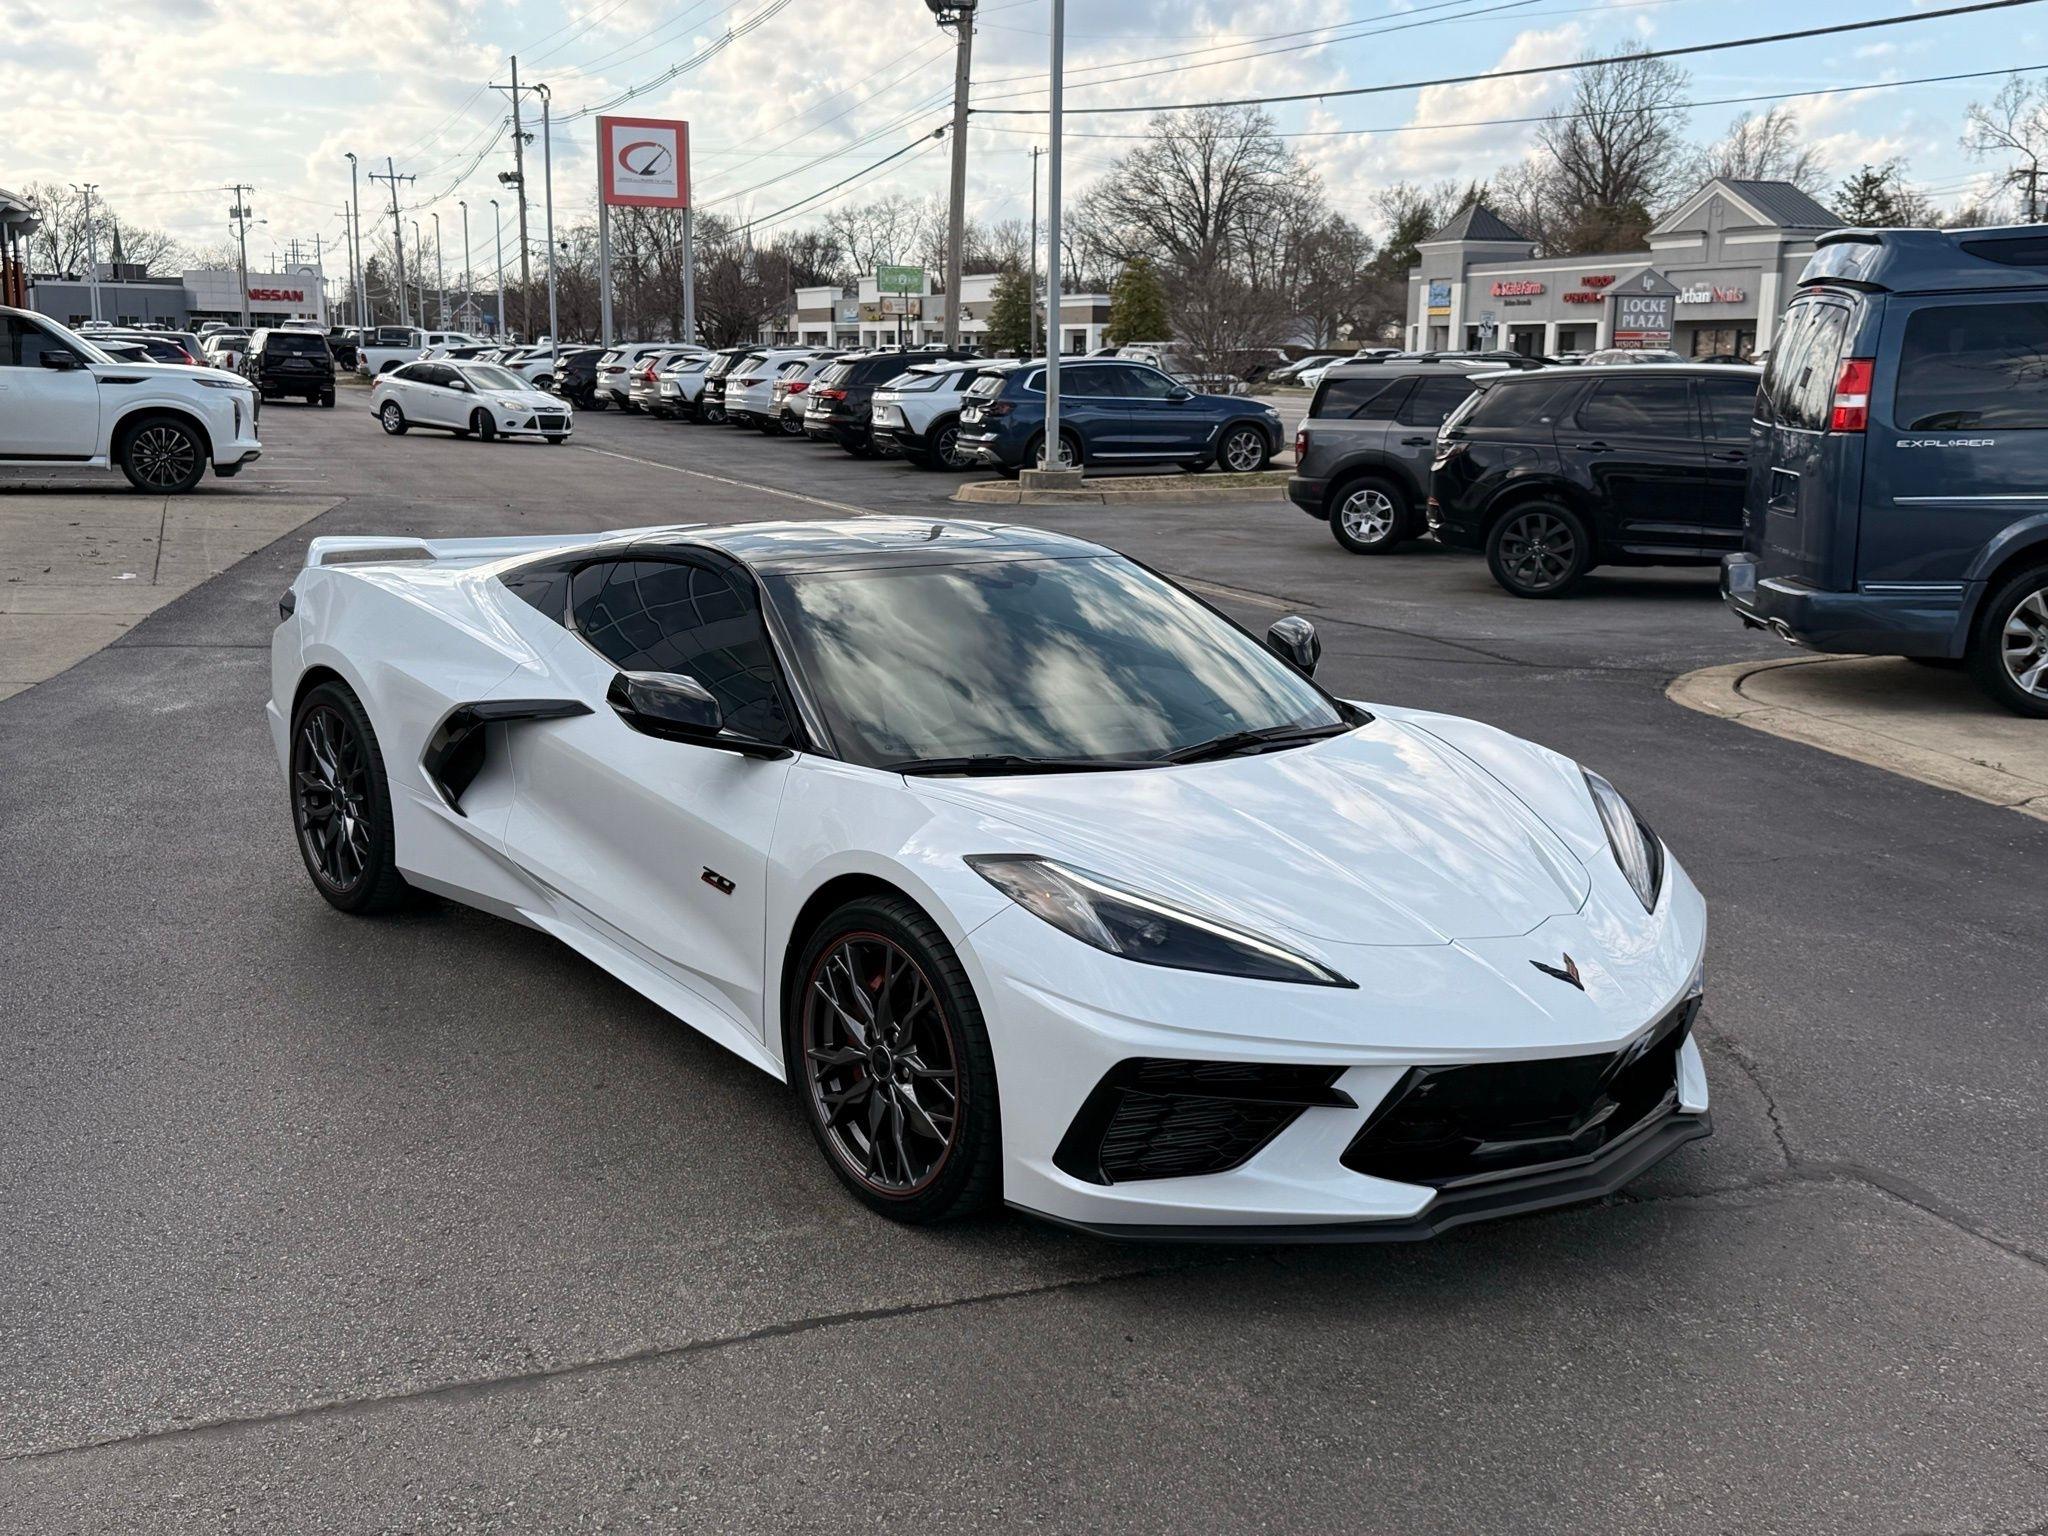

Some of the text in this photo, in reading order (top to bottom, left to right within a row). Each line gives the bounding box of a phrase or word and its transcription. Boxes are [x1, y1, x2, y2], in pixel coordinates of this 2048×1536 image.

[247, 288, 304, 303] NISSAN
[1675, 287, 1711, 303] Urban
[1623, 299, 1667, 313] LOCKE
[1622, 315, 1665, 328] PLAZA
[1896, 439, 1995, 448] EXPLORER
